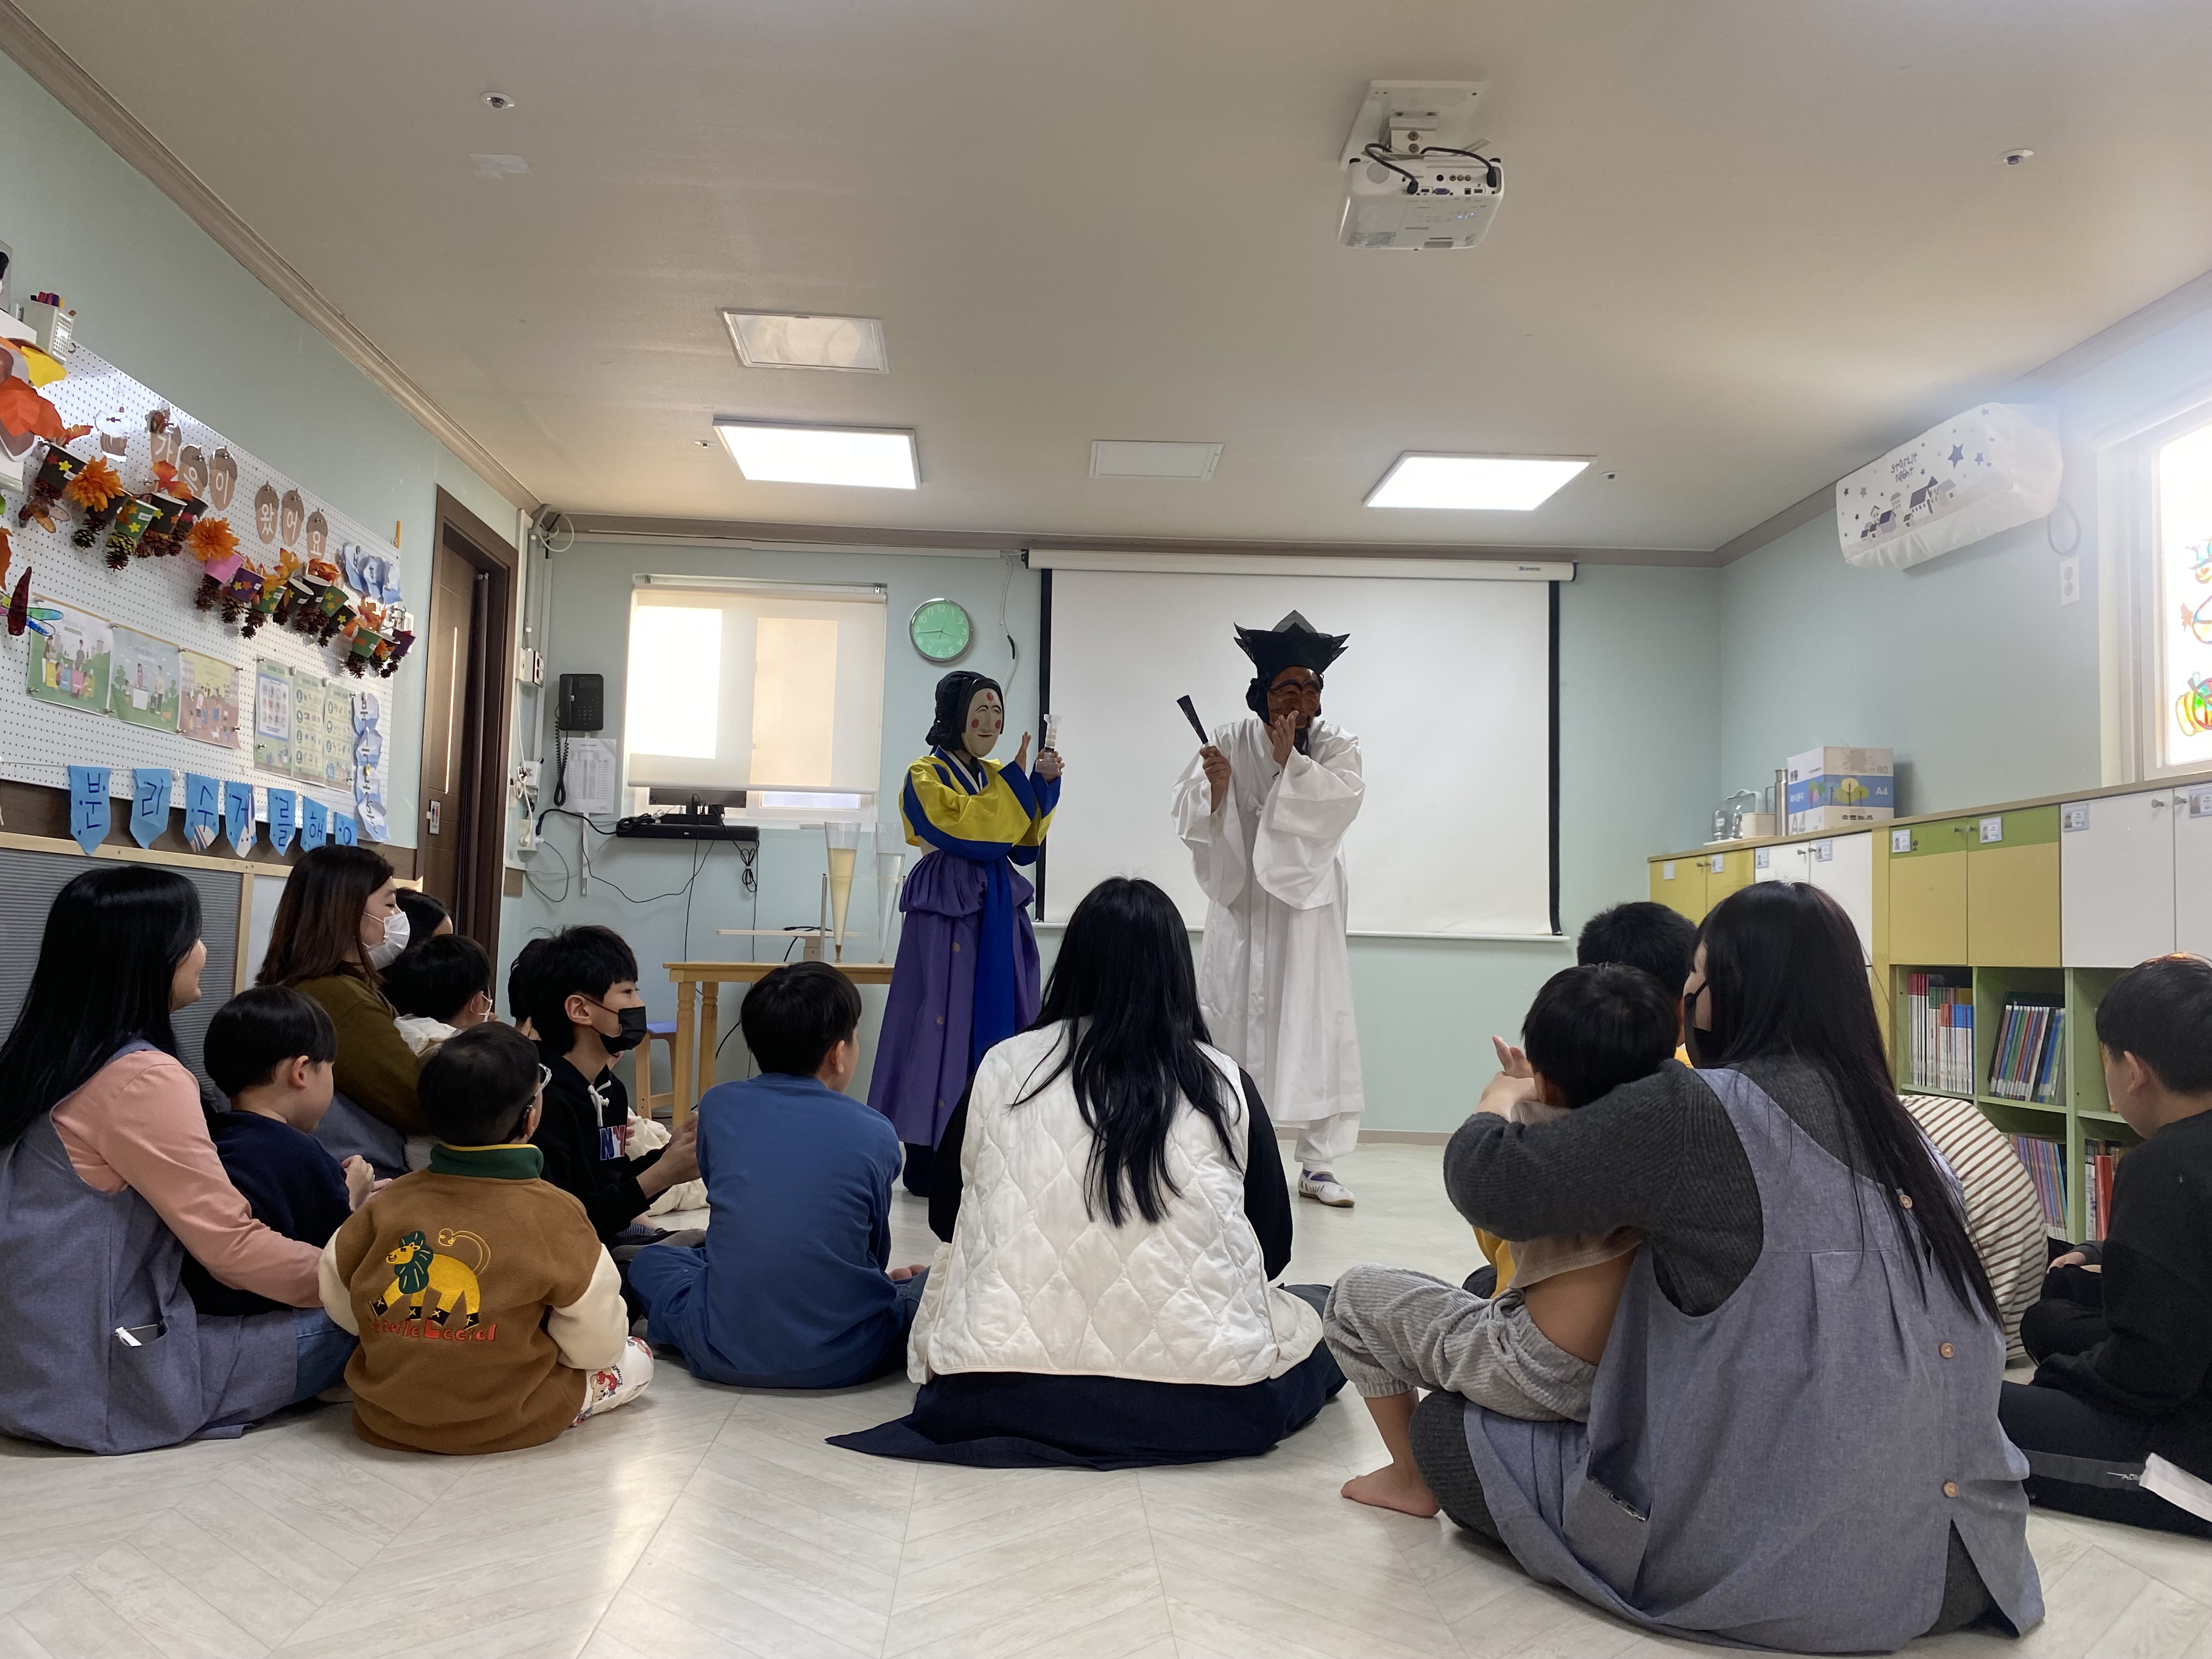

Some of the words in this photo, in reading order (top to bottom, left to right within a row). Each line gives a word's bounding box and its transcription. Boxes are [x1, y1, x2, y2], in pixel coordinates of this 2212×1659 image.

[918, 615, 927, 623] 10
[1876, 765, 1888, 774] 80
[1875, 787, 1888, 795] A4
[1791, 810, 1805, 834] A4
[599, 1125, 626, 1160] NY
